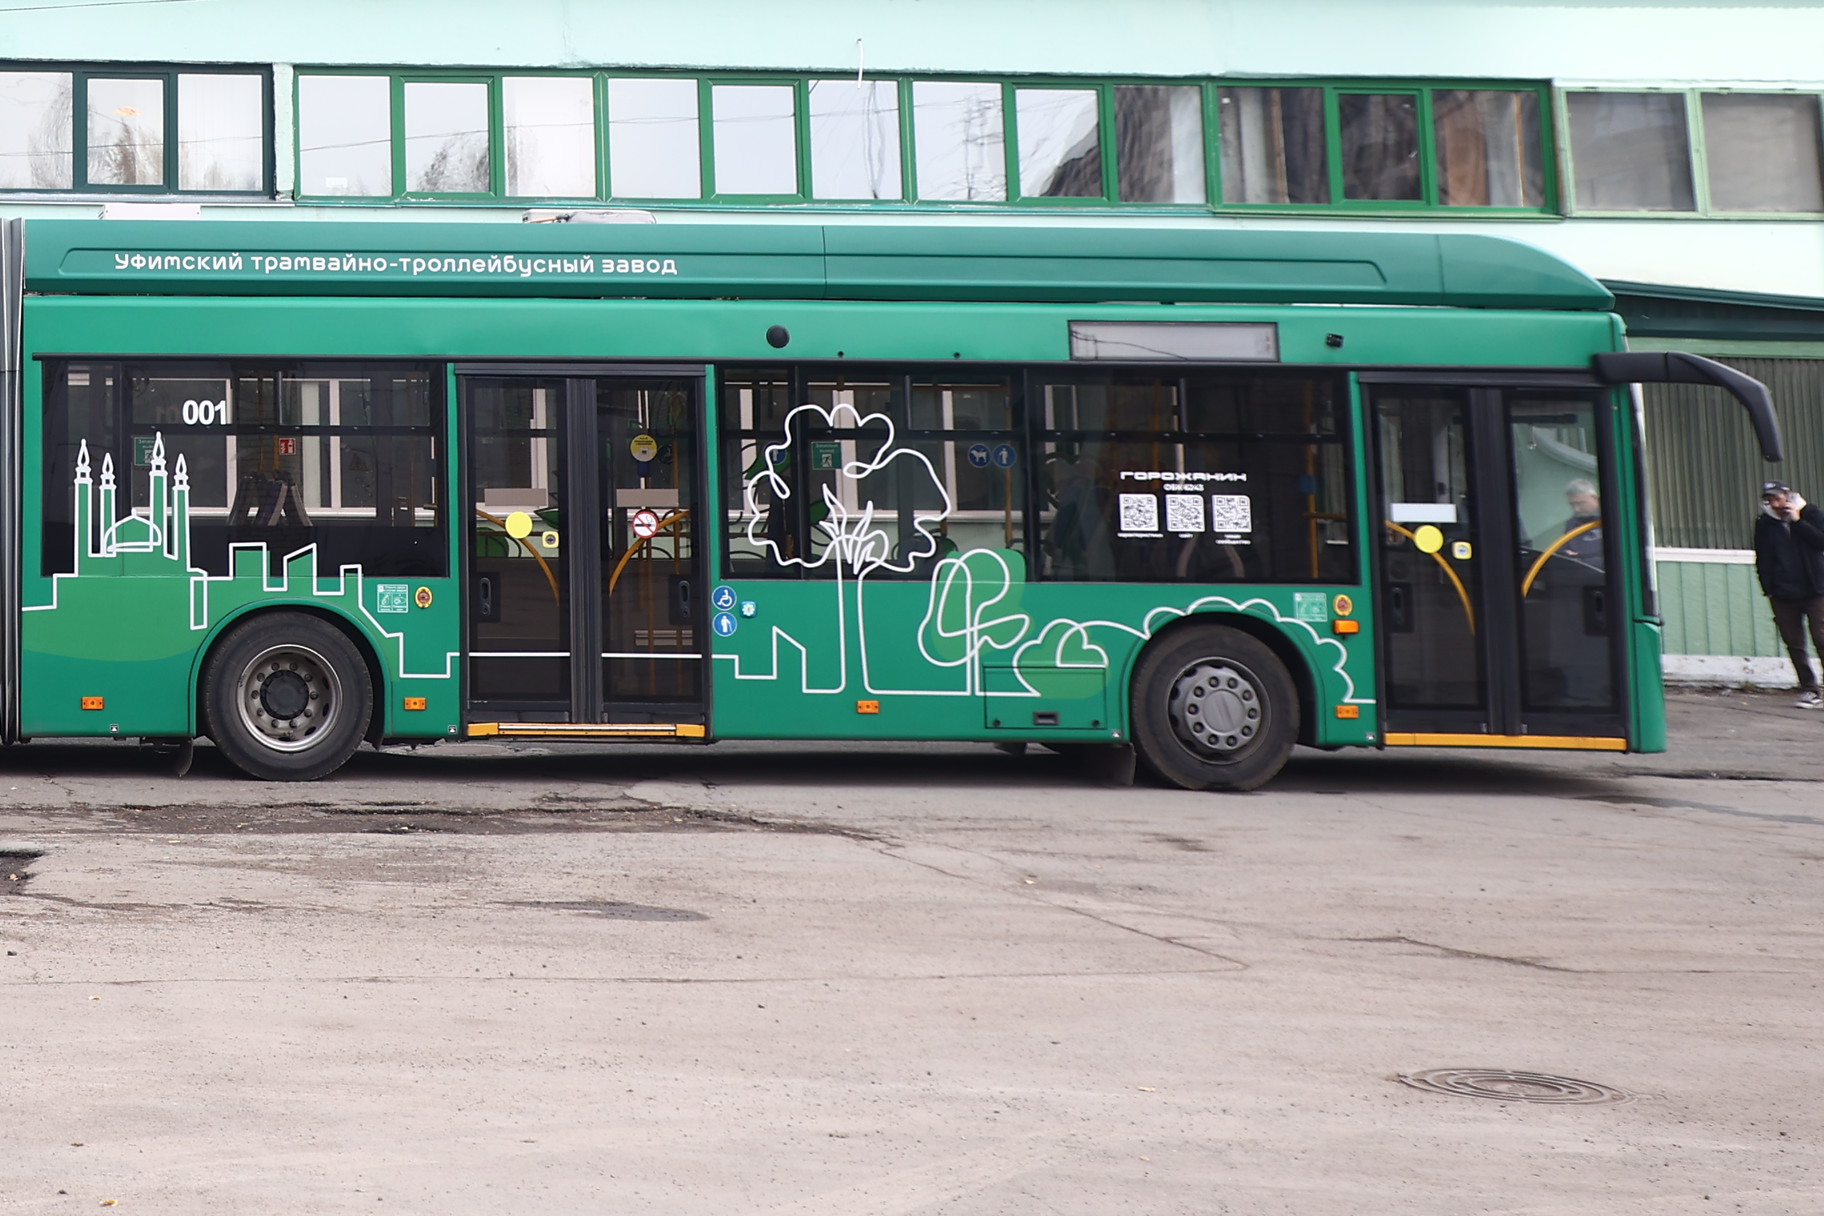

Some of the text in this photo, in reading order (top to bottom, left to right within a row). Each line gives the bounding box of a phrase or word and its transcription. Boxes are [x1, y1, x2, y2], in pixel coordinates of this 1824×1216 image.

[114, 252, 678, 277] Уфимский трамвайно-троллейбусный завод
[182, 399, 227, 426] 001
